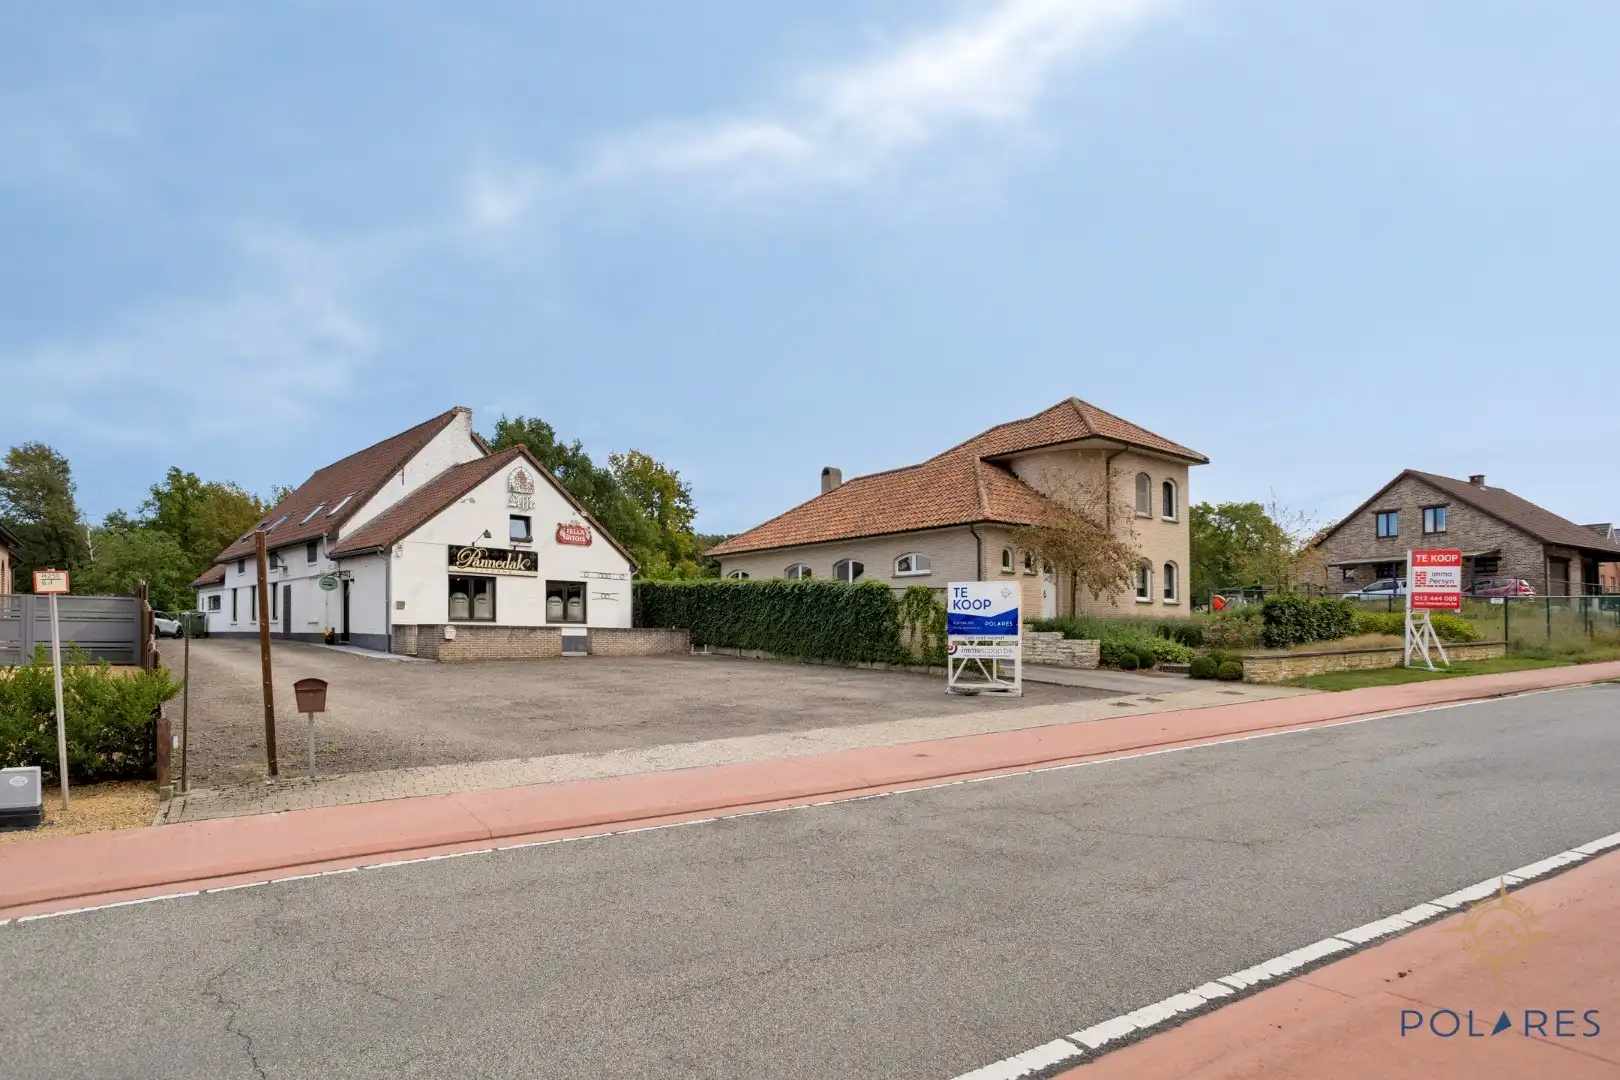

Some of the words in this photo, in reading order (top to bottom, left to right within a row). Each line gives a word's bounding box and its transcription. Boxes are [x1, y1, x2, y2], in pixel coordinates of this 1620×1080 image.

[509, 493, 536, 511] Leffe
[456, 546, 531, 571] Pannedak
[1416, 554, 1428, 563] TE
[1431, 554, 1458, 563] KOOP
[953, 587, 968, 598] TE
[953, 599, 992, 610] KOOP
